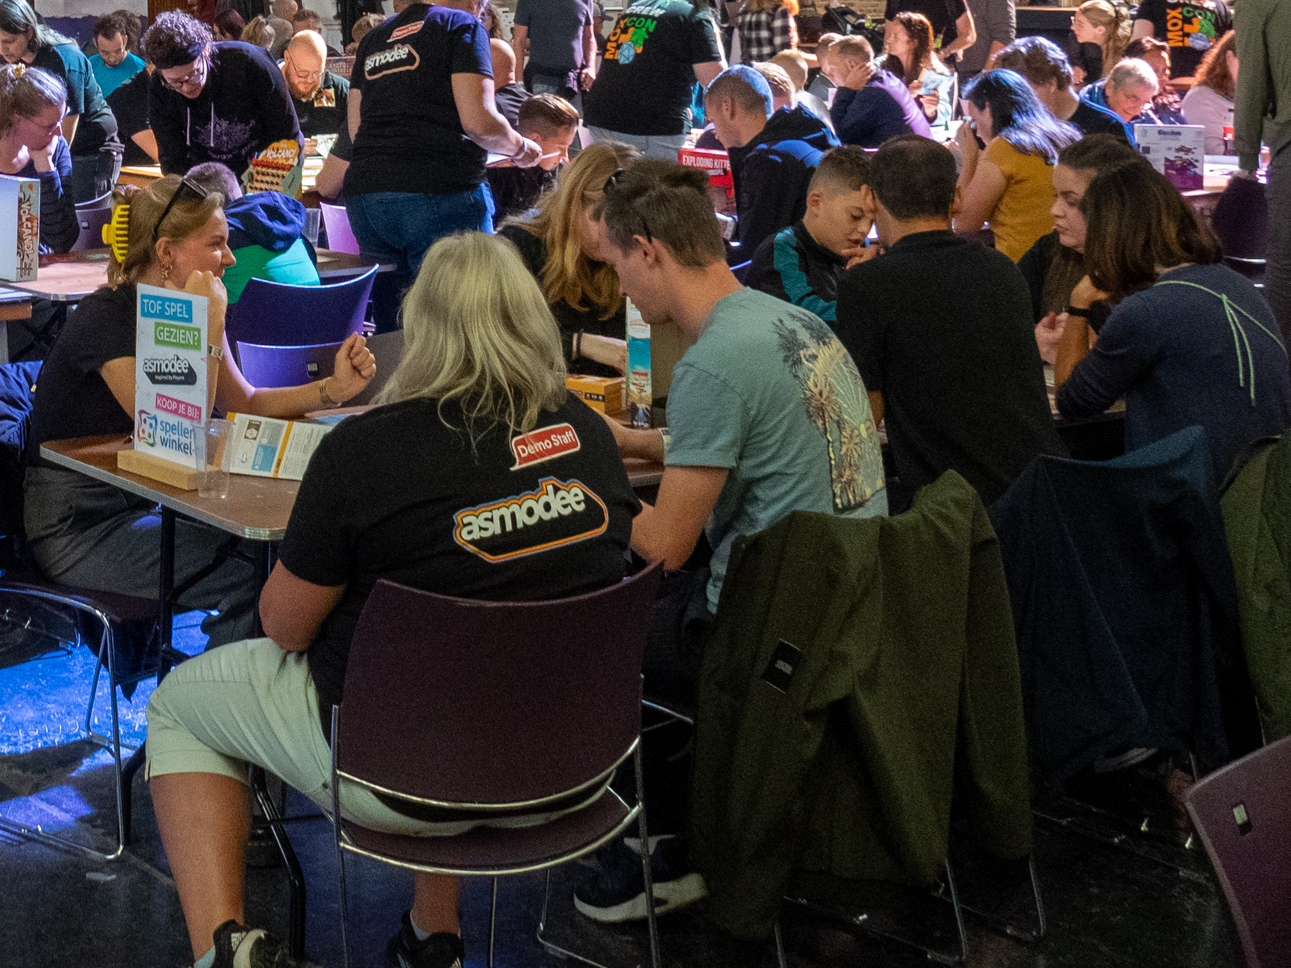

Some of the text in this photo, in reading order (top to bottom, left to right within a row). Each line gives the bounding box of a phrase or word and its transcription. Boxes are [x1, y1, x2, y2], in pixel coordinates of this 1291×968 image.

[626, 17, 657, 32] CON
[1182, 7, 1216, 23] CON
[1166, 7, 1184, 47] MOX
[365, 46, 409, 71] asmodee
[683, 155, 731, 171] EXPLODING KITTE
[142, 299, 189, 318] TOF SPEL
[156, 327, 199, 346] GEZIEN?
[143, 354, 189, 373] asmodee
[157, 396, 200, 419] KOOP JE BIJ:
[517, 430, 576, 458] Demo Staff
[460, 485, 586, 541] asmodee
